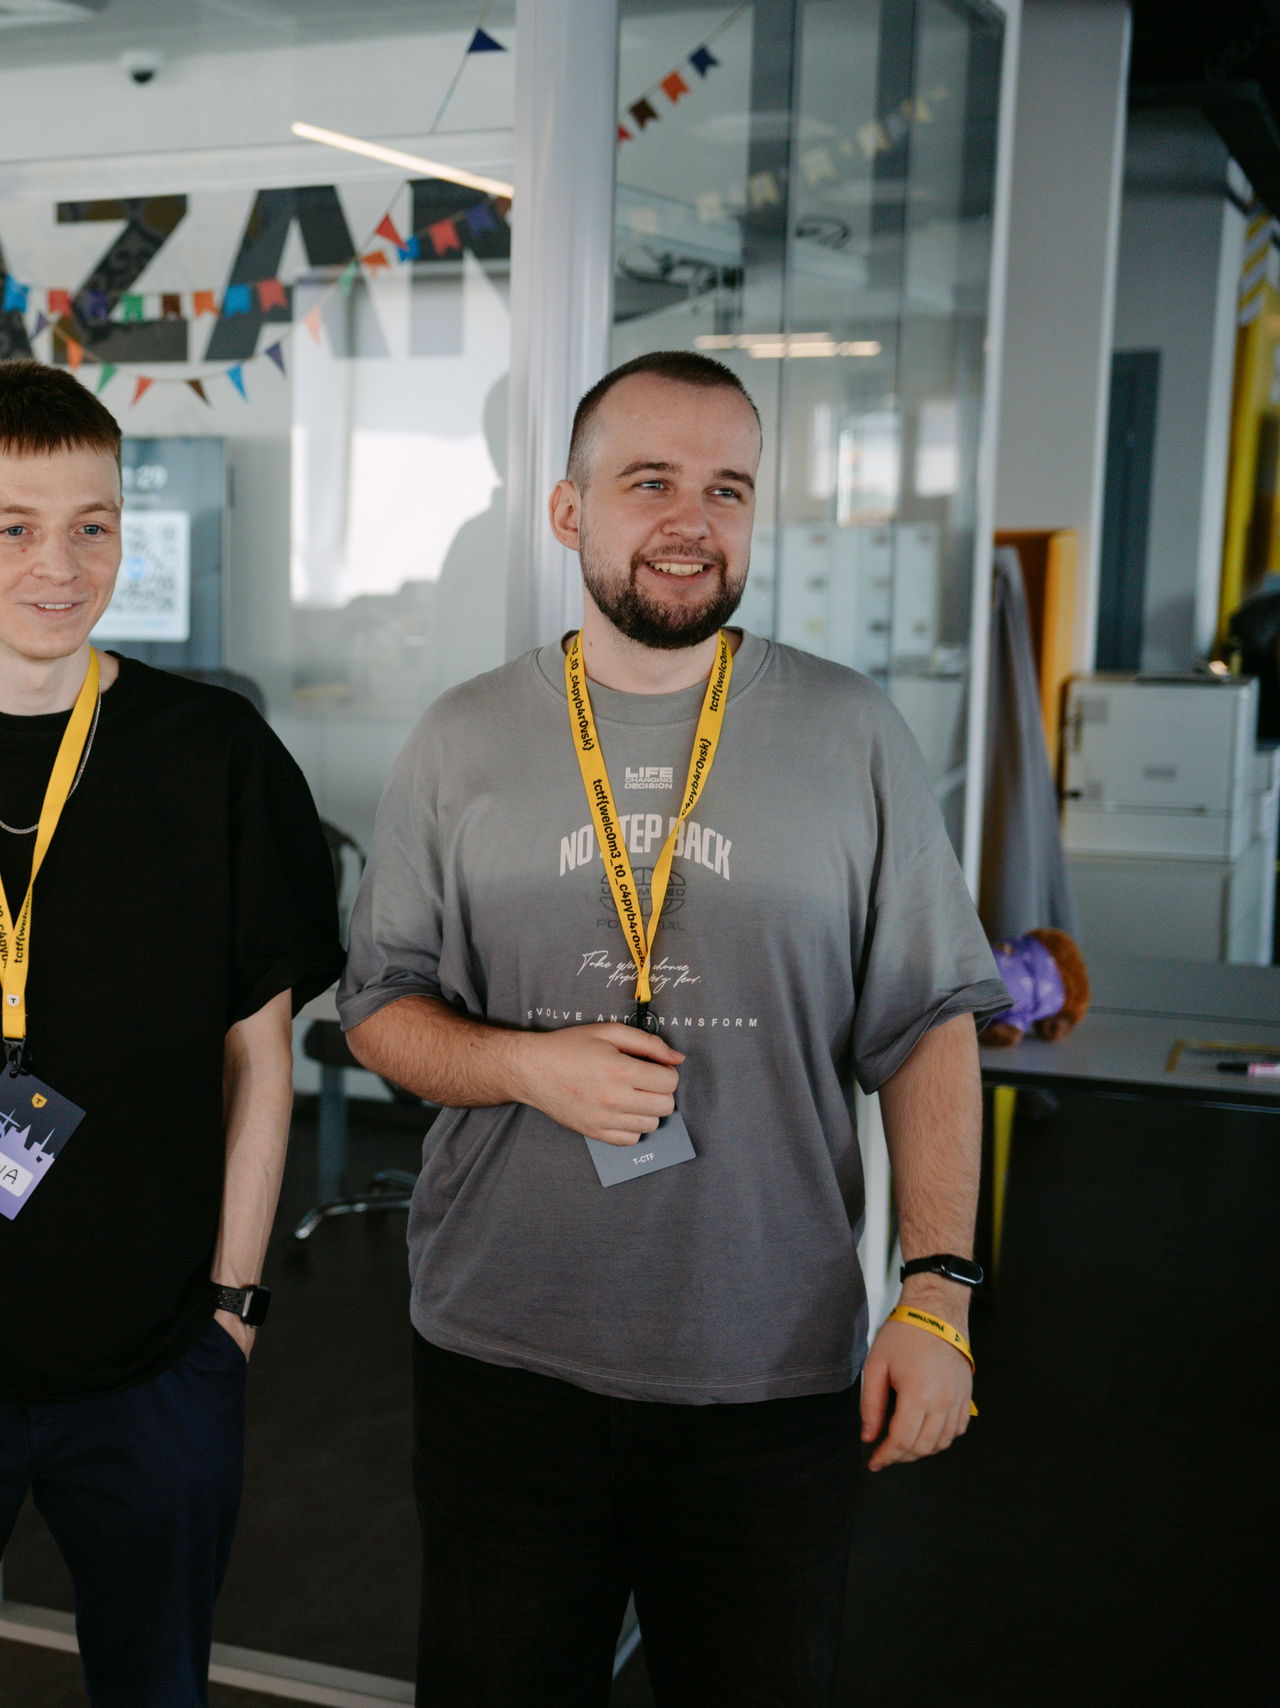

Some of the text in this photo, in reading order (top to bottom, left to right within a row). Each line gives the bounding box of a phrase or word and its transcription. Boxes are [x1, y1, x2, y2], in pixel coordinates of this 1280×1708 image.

[625, 767, 673, 778] LIFE
[560, 813, 733, 881] NO TEP BACK
[576, 950, 612, 976] Take
[527, 1007, 583, 1021] EVOLVE
[646, 1016, 758, 1028] TRANSFORM
[632, 1152, 655, 1166] T-CTF
